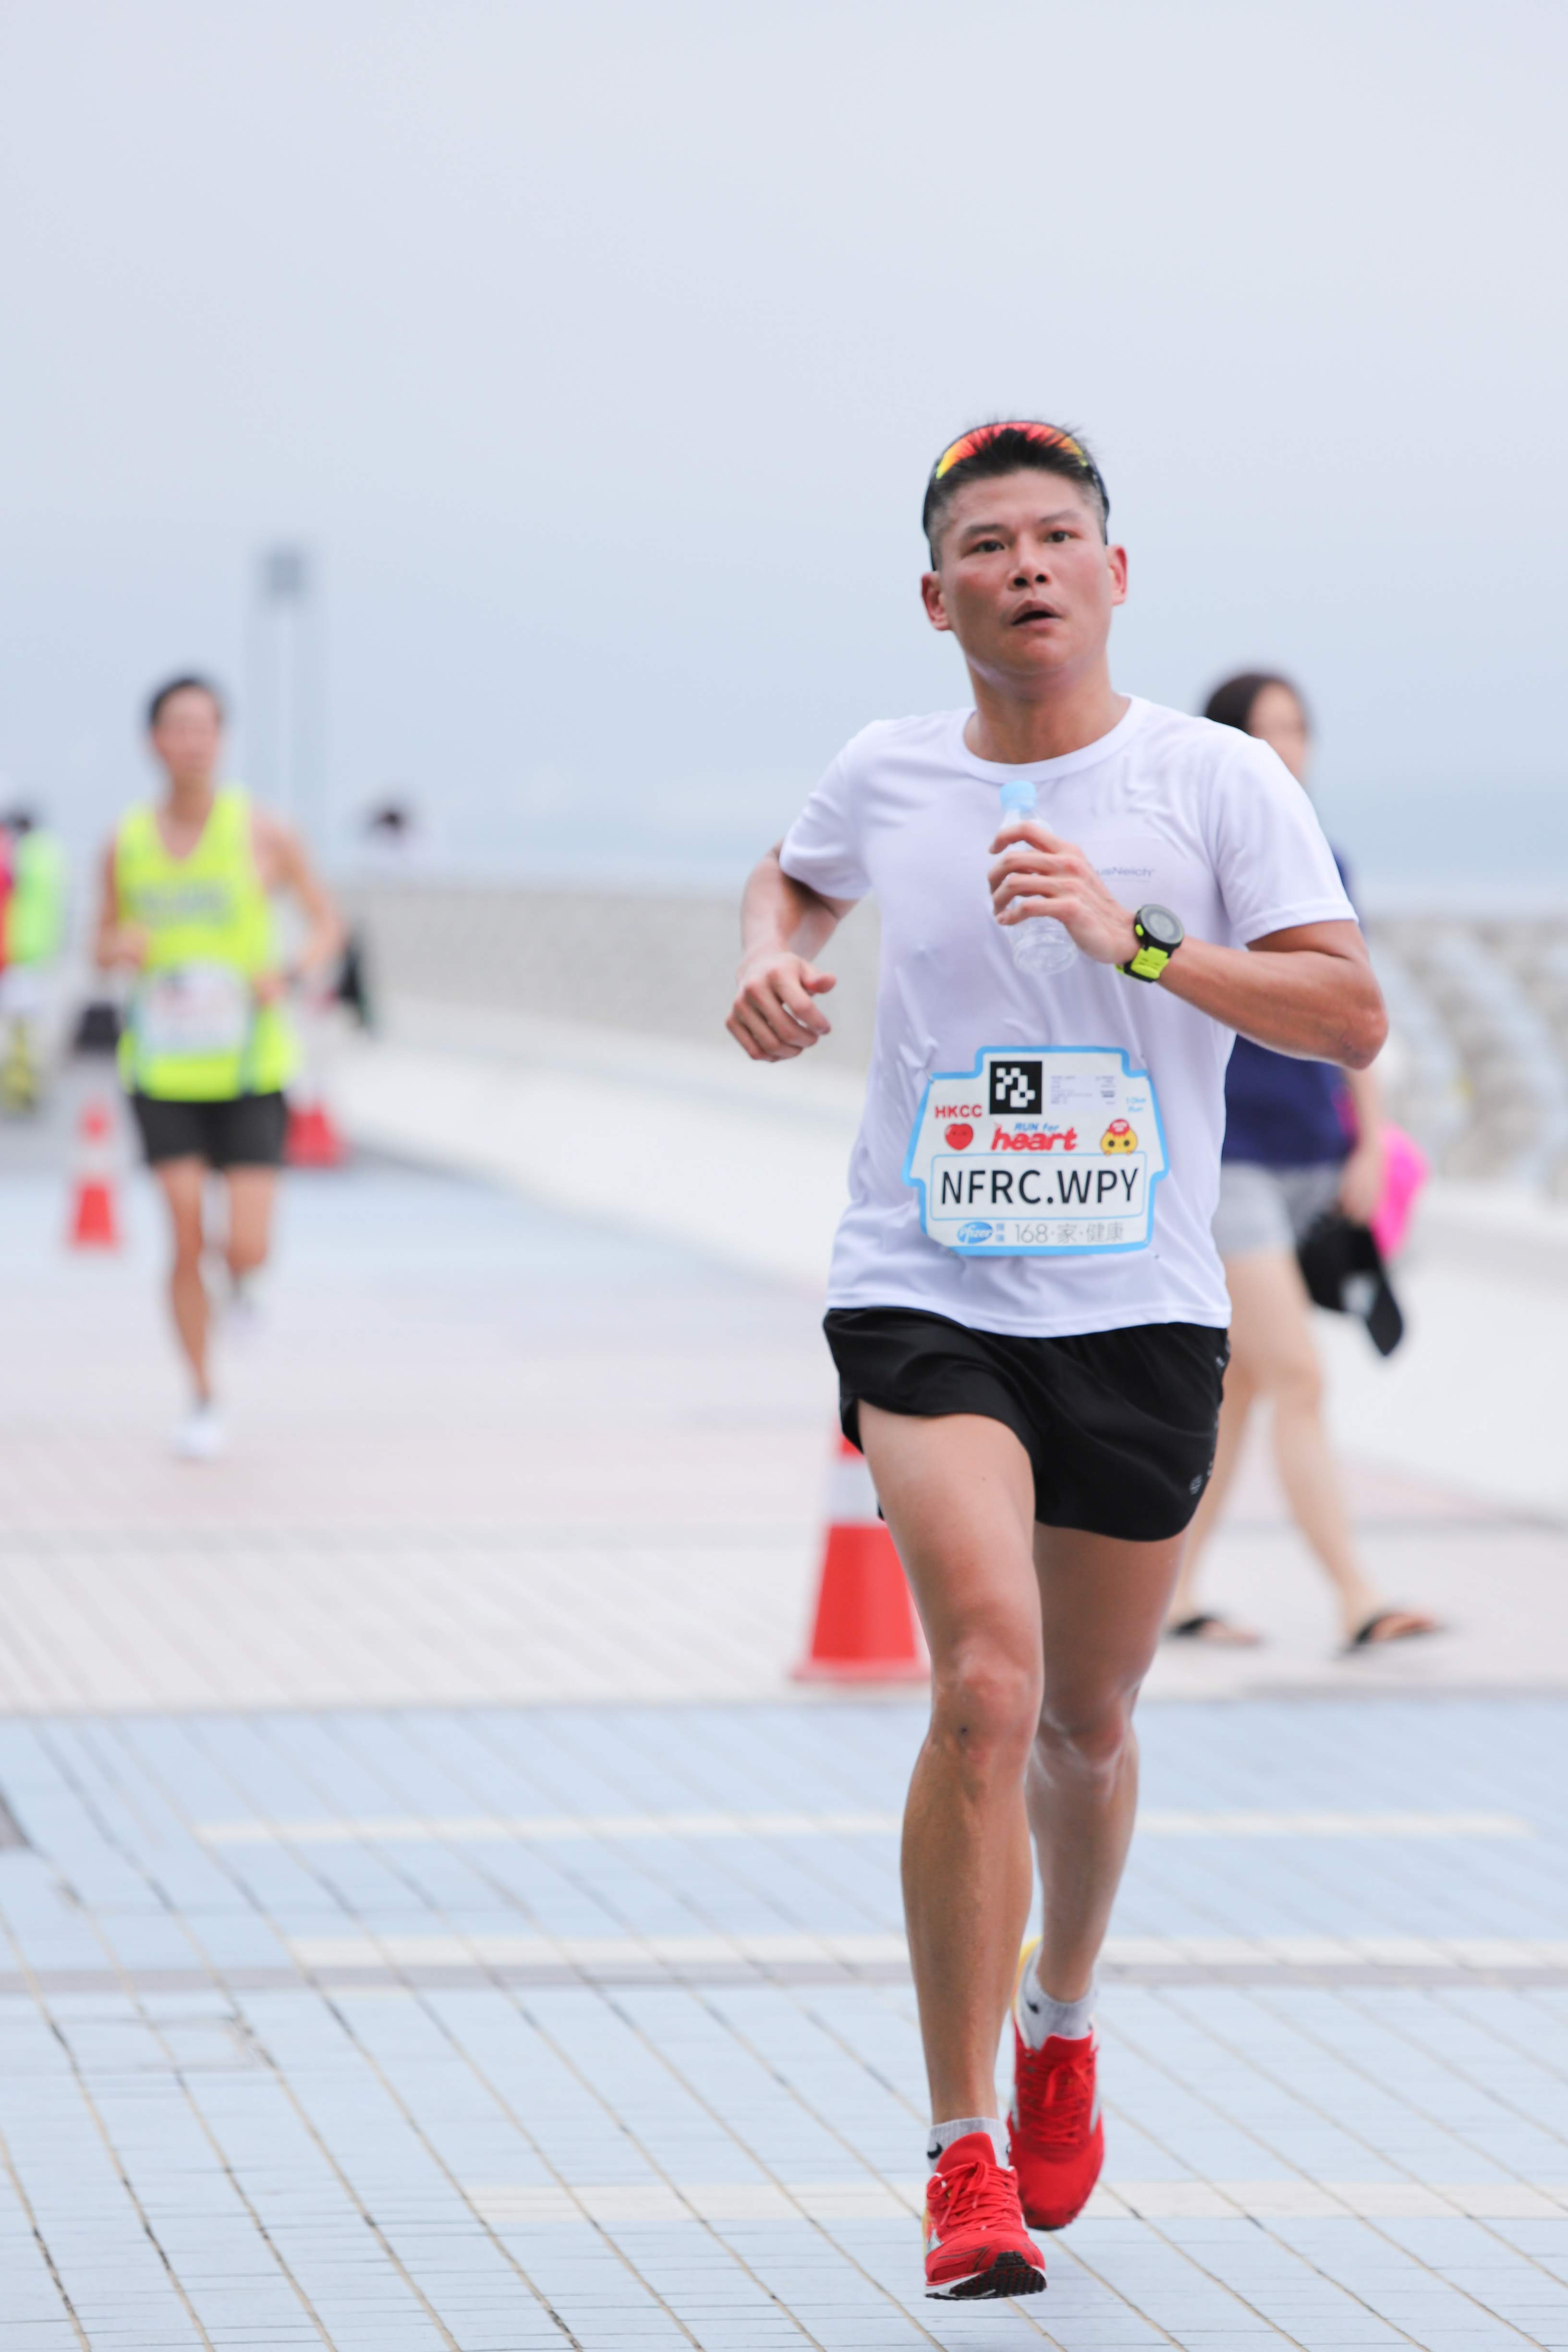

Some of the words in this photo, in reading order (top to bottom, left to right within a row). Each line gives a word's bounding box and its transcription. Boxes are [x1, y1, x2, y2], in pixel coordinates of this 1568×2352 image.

[935, 1104, 983, 1118] HKCC
[1014, 1122, 1039, 1131] RUN
[991, 1125, 1078, 1151] heart
[941, 1168, 1138, 1204] NFRC.WPY
